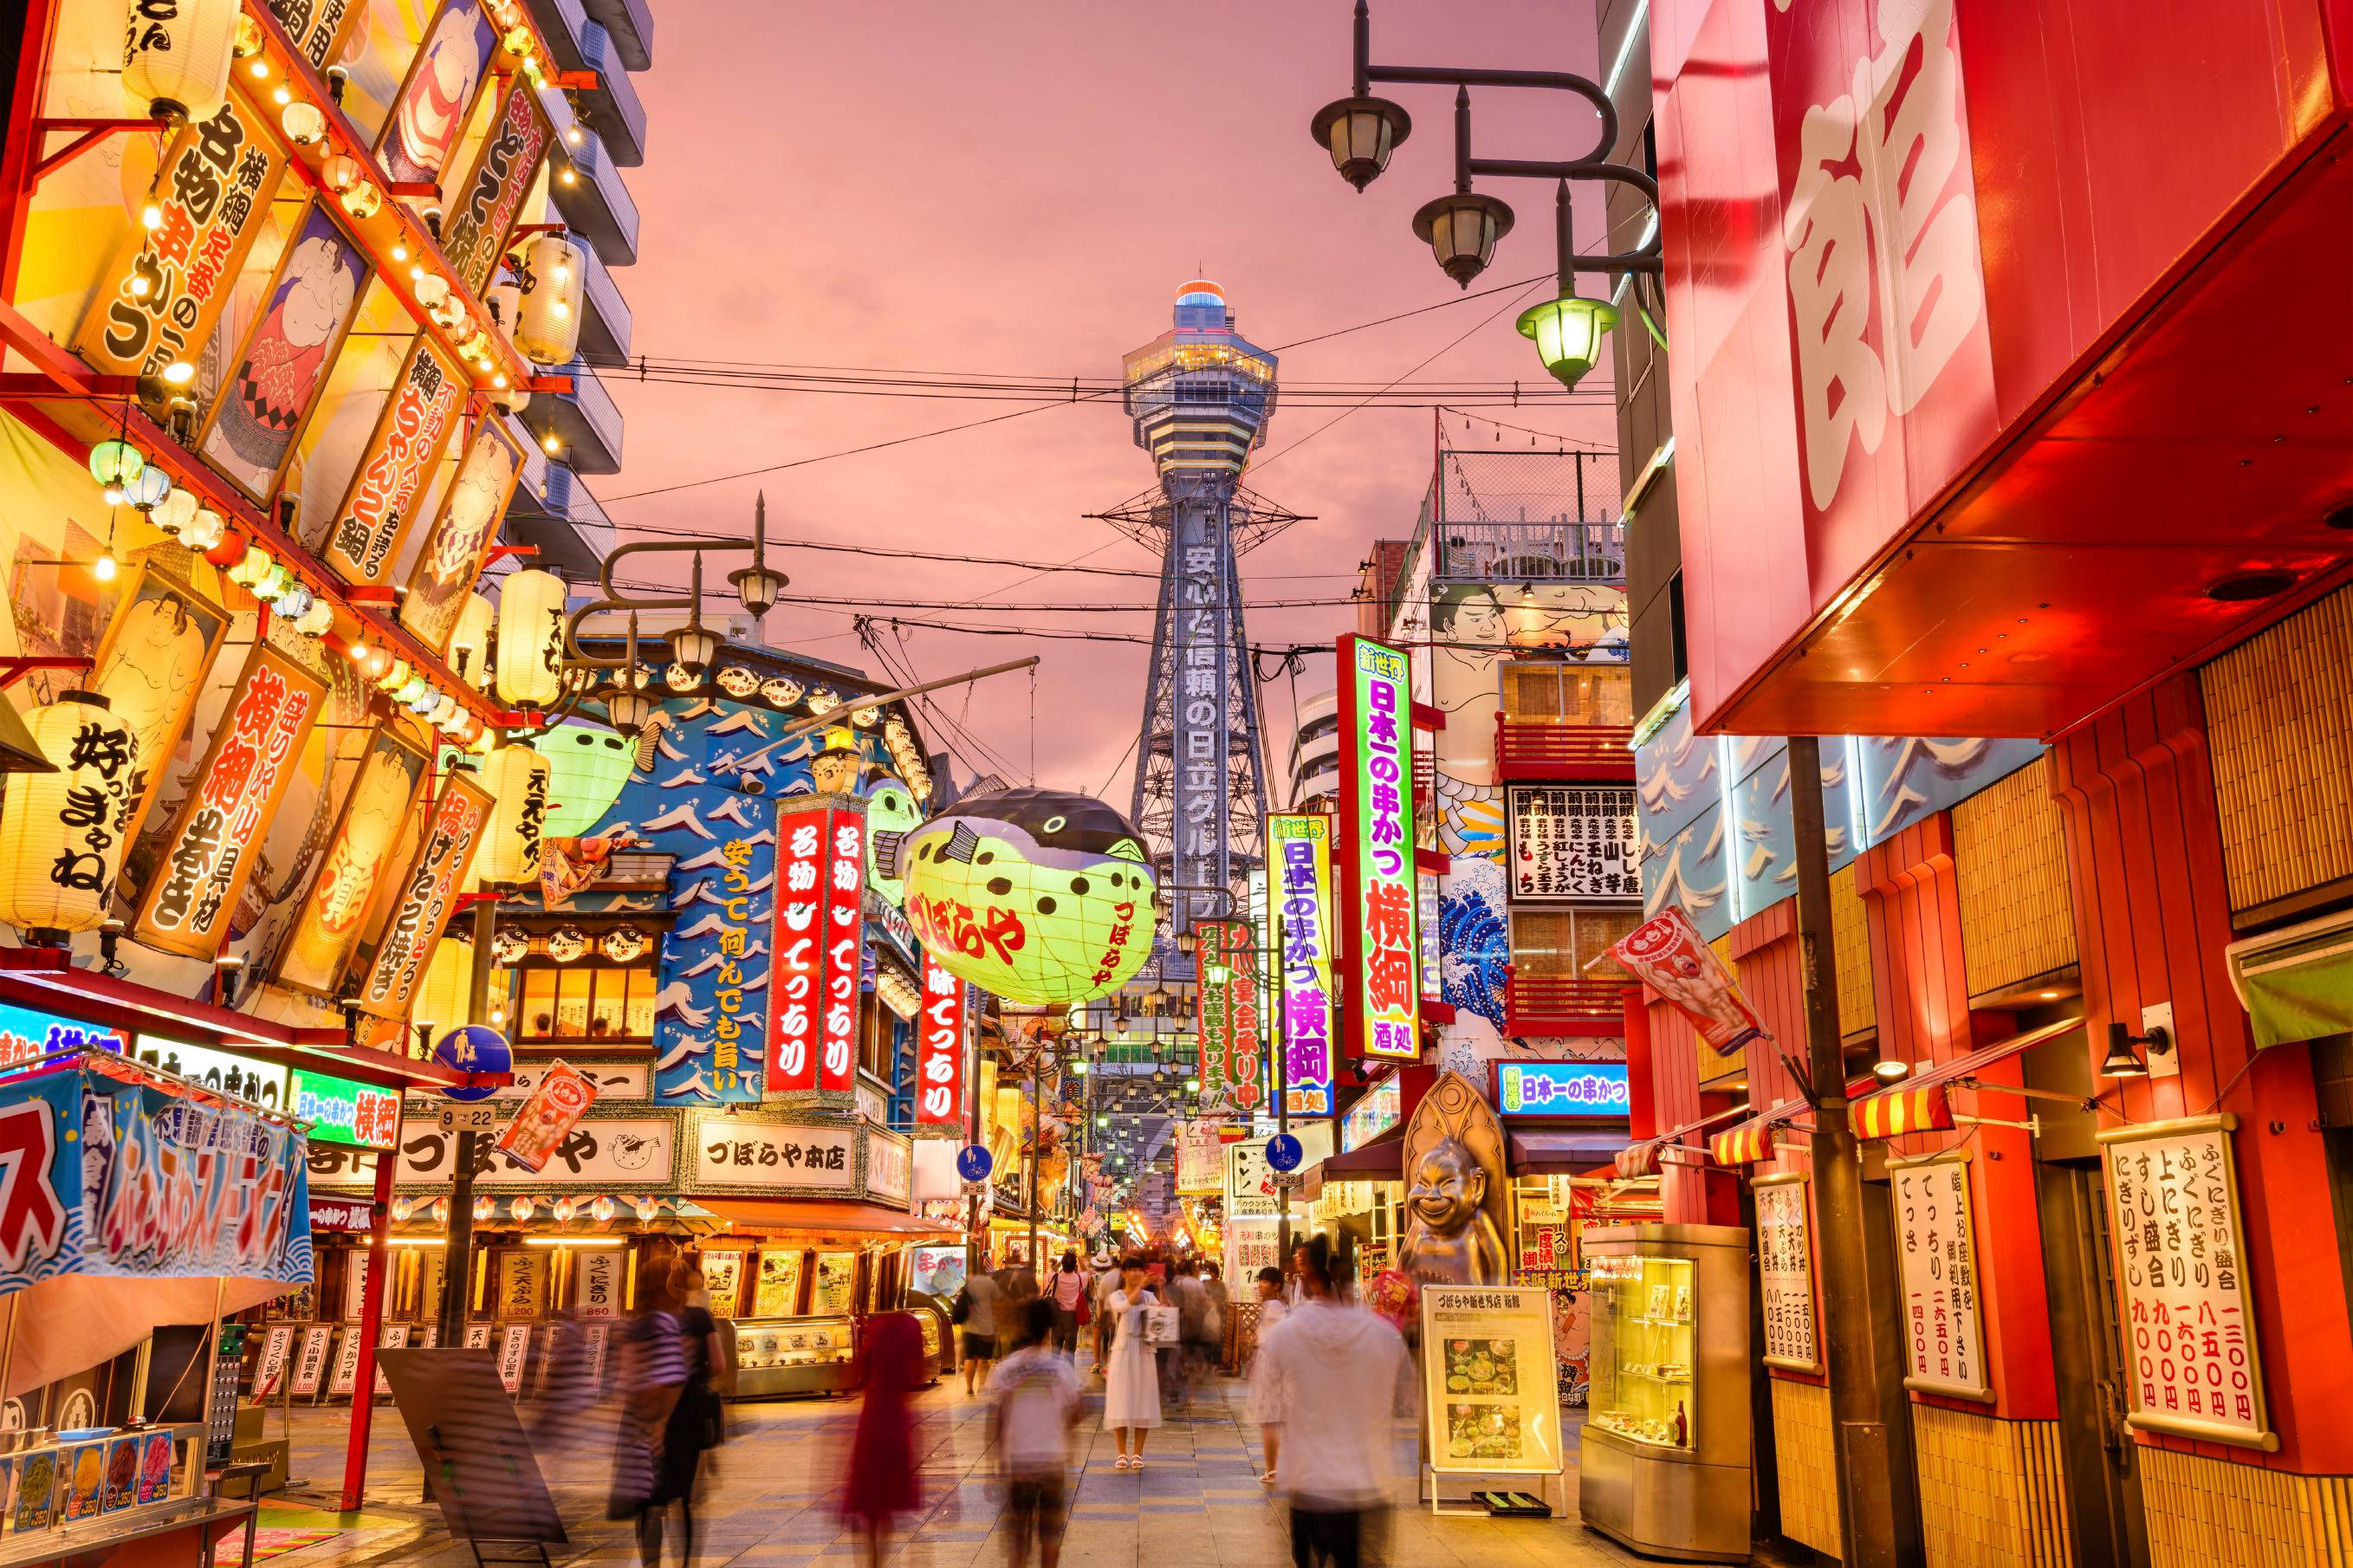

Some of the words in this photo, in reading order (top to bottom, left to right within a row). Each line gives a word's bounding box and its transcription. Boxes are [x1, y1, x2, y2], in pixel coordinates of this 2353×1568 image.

[106, 103, 243, 360] 名物串かつ
[471, 126, 542, 293] 大阪下町の味
[335, 348, 443, 567] 横綱ちゃんこ鍋
[366, 382, 457, 579] 不動の人気を誇る
[1358, 645, 1404, 683] 新世界
[153, 666, 287, 930] 横綱巻き
[192, 690, 310, 935] 盛り沢山具材
[1368, 678, 1403, 877] 日本一の串かつ
[789, 825, 818, 891] 名物
[833, 825, 859, 891] 名物
[1274, 820, 1325, 839] 新世界
[1519, 841, 1534, 893] もち
[1536, 841, 1552, 893] うずら玉子
[1552, 841, 1571, 893] 紅しょうが
[1569, 841, 1586, 893] にんにく
[1587, 841, 1604, 893] 玉ねぎ
[1604, 841, 1621, 893] 山芋
[1622, 841, 1639, 893] しし唐
[369, 789, 469, 1002] 揚げたこ焼き
[908, 891, 1026, 966] づぼらや
[1283, 842, 1317, 984] 日本一の串かつ
[713, 839, 753, 1091] 安うて何んでも旨い
[1091, 900, 1136, 988] づぼらや
[1366, 879, 1411, 1016] 横綱
[779, 939, 813, 1076] てっちり
[825, 939, 854, 1076] てっちり
[924, 956, 957, 1118] 味てっちり
[1276, 988, 1328, 1085] 横綱
[1374, 1020, 1413, 1053] 酒処
[299, 1093, 354, 1125] 日本一の串かつ
[354, 1092, 398, 1144] 横綱
[1522, 1077, 1626, 1102] 日本一の串かつ
[404, 1129, 598, 1174] づぼや
[707, 1139, 846, 1170] づぼらや本店
[1901, 1176, 1917, 1254] てっさ
[1922, 1175, 1942, 1280] てっちり
[2115, 1154, 2142, 1288] にぎりずし
[2136, 1150, 2166, 1288] すし盛合
[2160, 1149, 2185, 1288] 上にぎり
[2179, 1147, 2210, 1289] ふぐにぎり
[2202, 1144, 2236, 1291] ふぐにぎり盛合
[1438, 1293, 1501, 1309] づぼらや新世界店
[302, 1332, 324, 1379] ふぐ小鍋定食
[504, 1329, 523, 1378] にぎりずし定食
